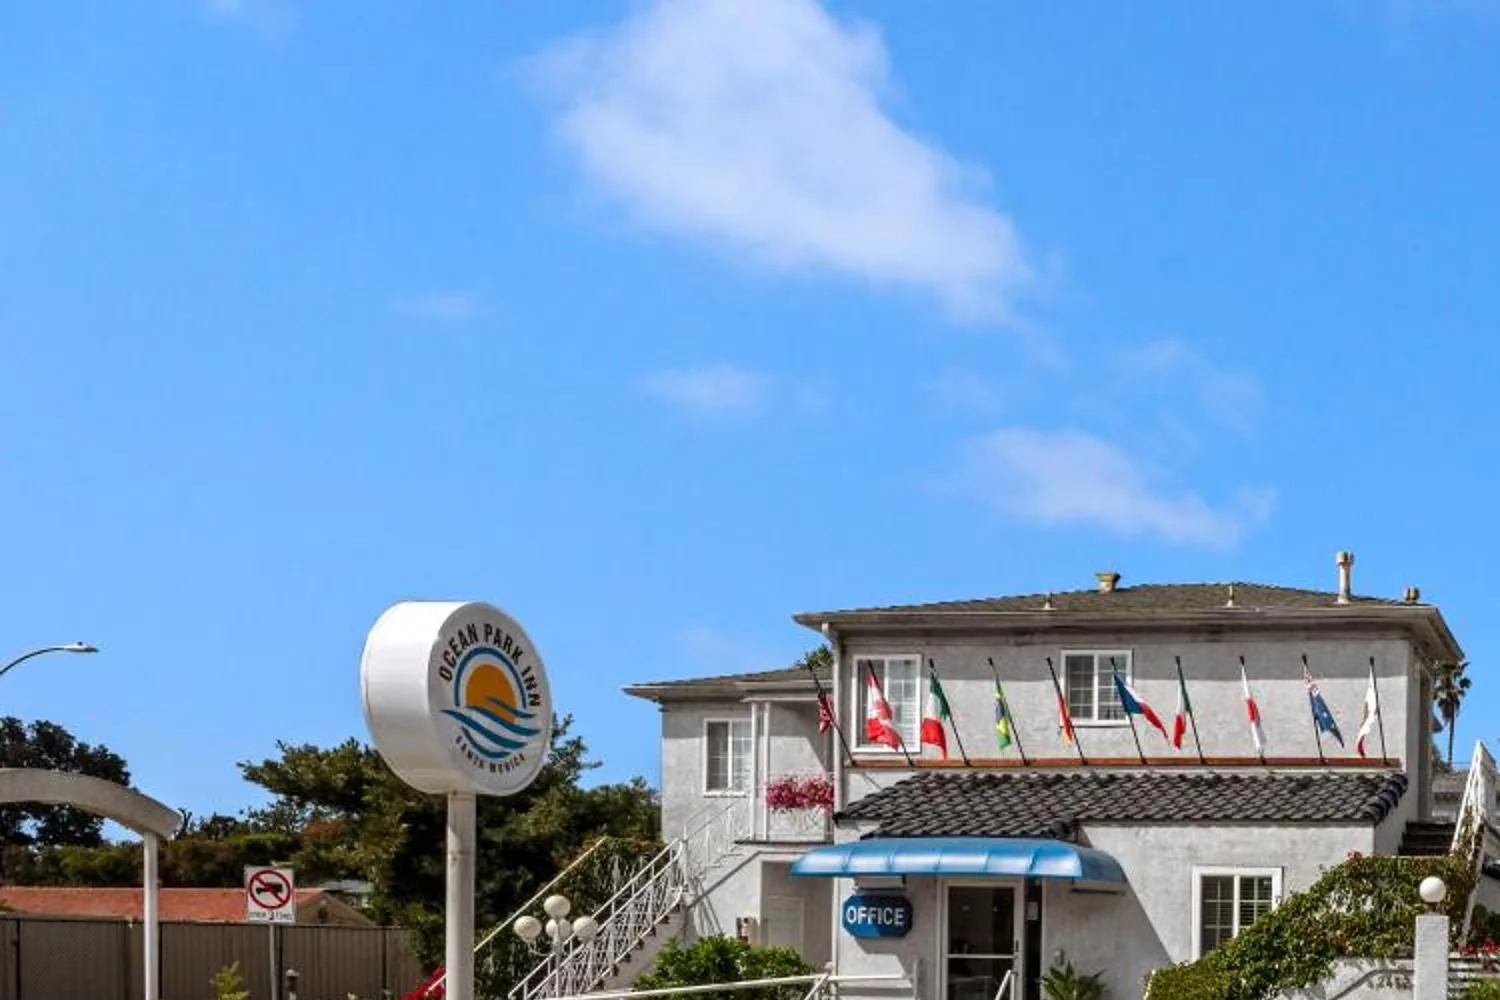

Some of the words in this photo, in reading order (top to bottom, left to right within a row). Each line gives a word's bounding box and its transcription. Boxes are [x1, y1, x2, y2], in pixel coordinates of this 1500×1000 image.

[438, 623, 479, 683] OCEAN
[484, 623, 524, 666] PARK
[521, 665, 541, 707] INN
[845, 905, 905, 926] OFFICE
